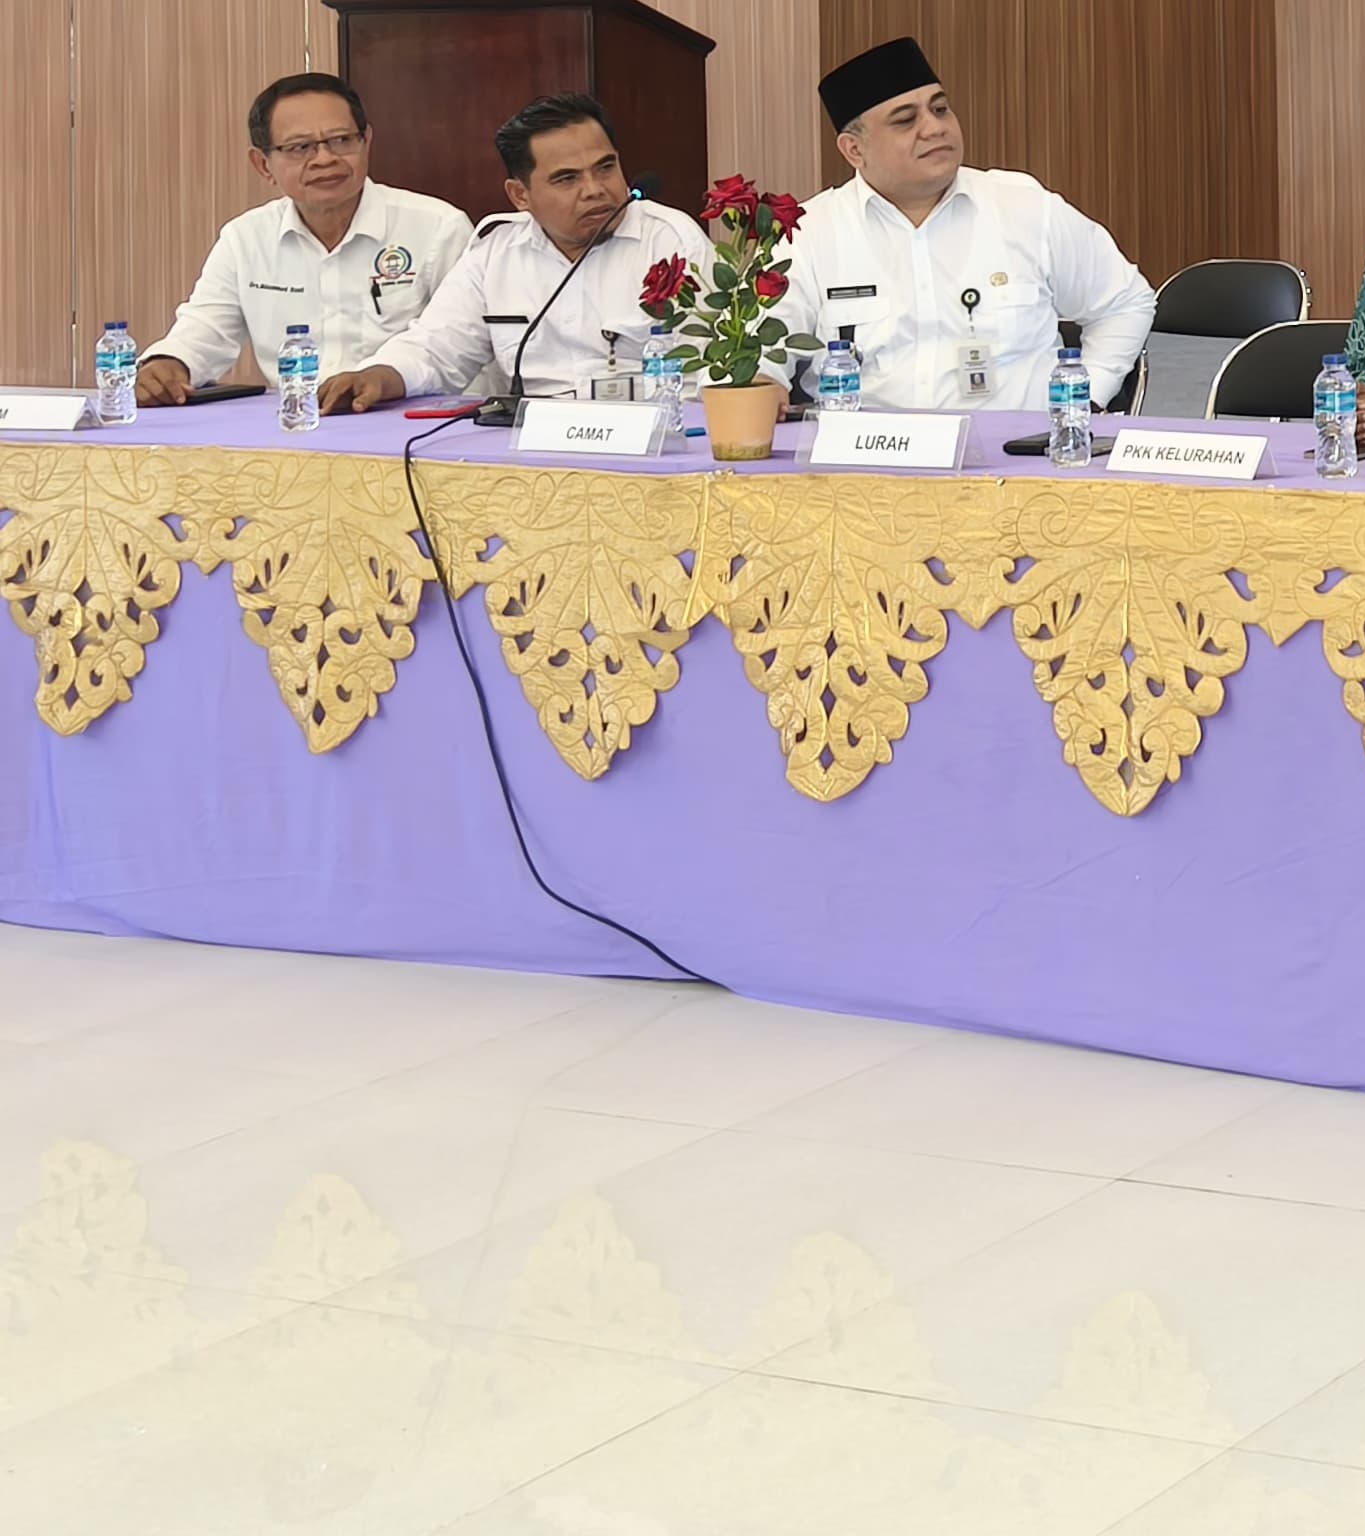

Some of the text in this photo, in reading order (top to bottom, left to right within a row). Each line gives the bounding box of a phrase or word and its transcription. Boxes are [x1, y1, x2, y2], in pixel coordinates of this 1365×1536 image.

[565, 425, 615, 443] CAMAT
[855, 433, 911, 453] LURAH
[1122, 444, 1246, 466] PKK KELURAHAN
